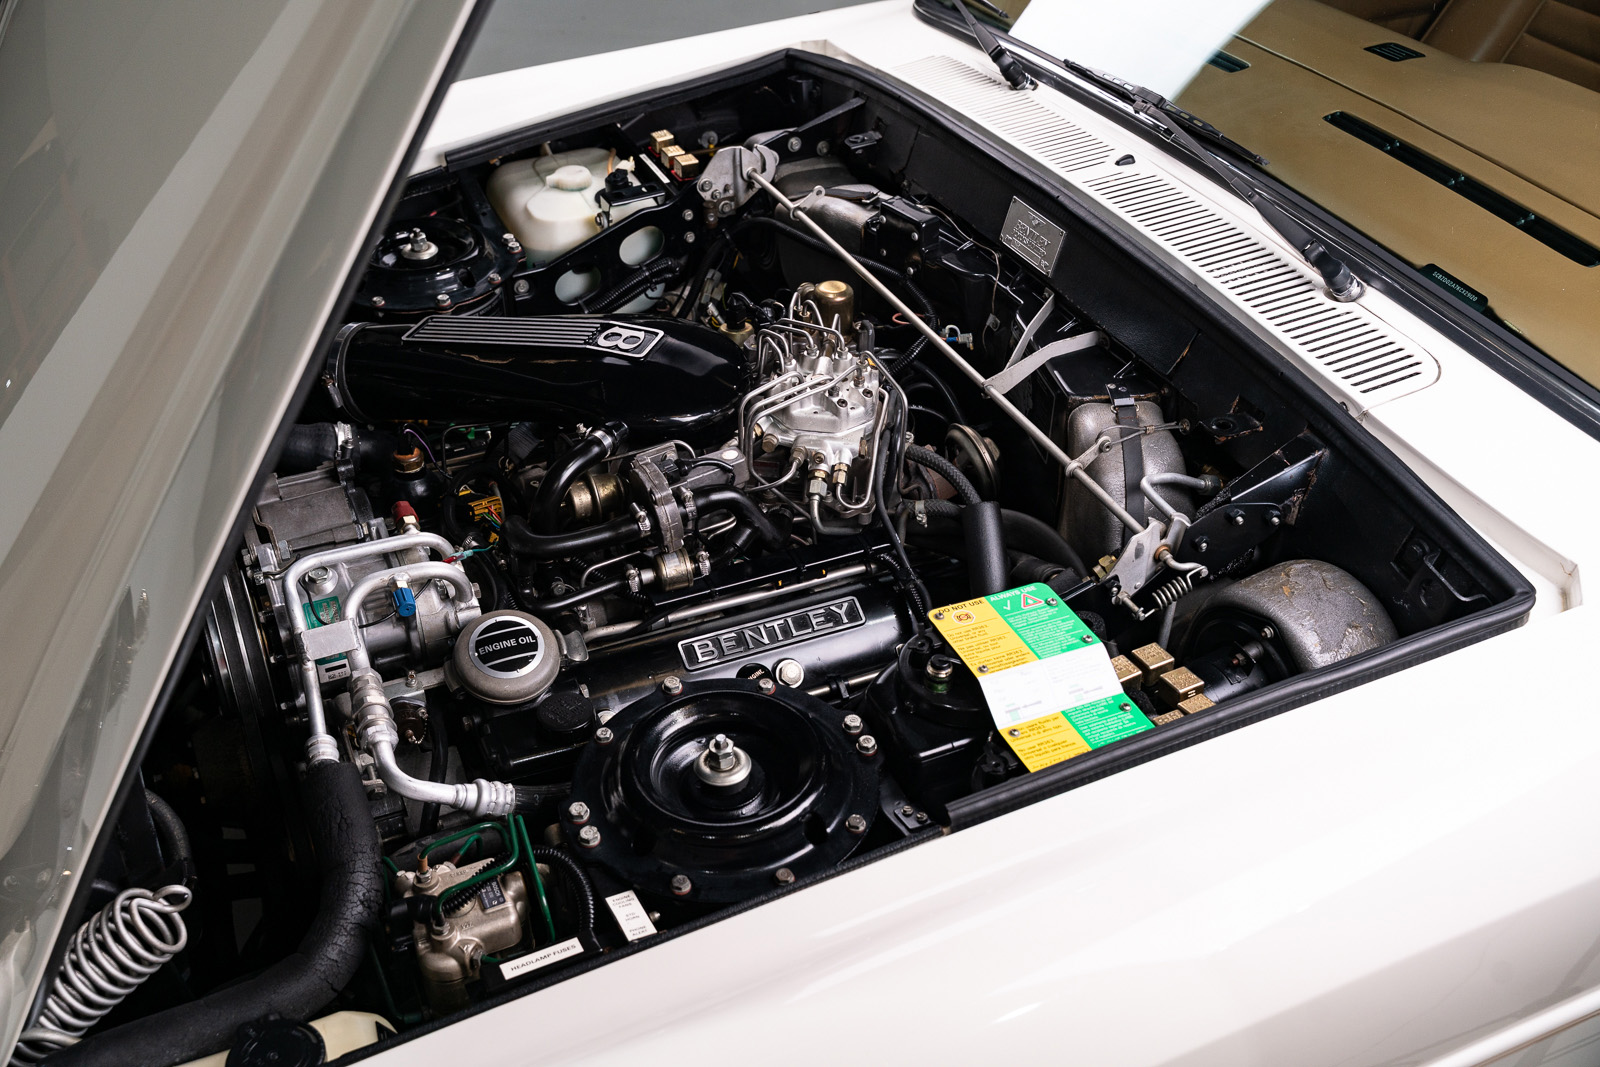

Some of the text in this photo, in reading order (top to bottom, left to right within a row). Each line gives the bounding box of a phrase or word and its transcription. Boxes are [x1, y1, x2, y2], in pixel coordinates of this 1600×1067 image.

[990, 590, 1021, 601] ALWAYS
[478, 634, 536, 656] ENGINE OIL
[692, 604, 851, 662] BENTLEY
[510, 944, 576, 972] HEADLAMP FUSES
